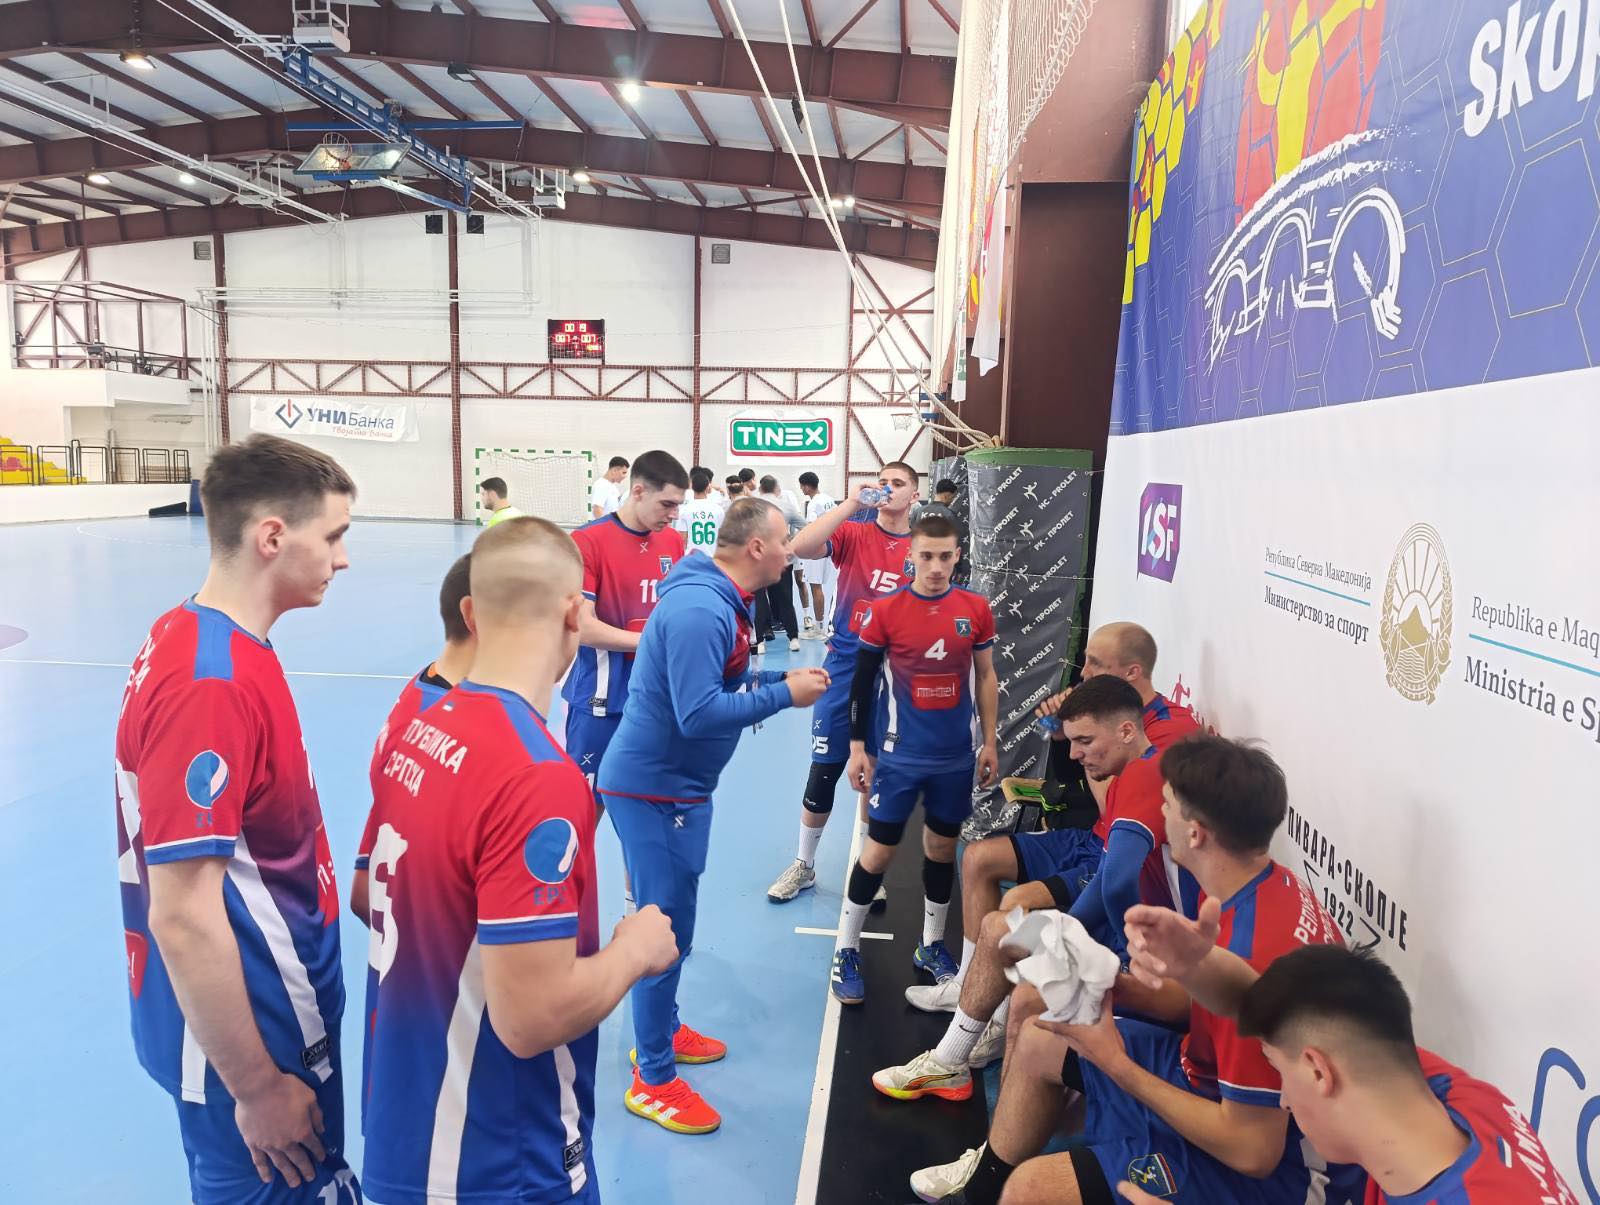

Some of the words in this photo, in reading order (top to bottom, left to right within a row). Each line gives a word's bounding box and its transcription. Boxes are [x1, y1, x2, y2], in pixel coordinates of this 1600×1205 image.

[737, 426, 824, 447] TINEX
[998, 466, 1023, 493] PROLET
[1052, 470, 1078, 497] PROLET
[692, 511, 714, 520] KSA
[1047, 510, 1075, 539] ПРОЛЕТ
[691, 521, 716, 546] 66
[869, 568, 901, 593] 15
[1042, 555, 1068, 580] PROLET
[1265, 547, 1296, 569] Република
[1296, 555, 1323, 578] Северна
[1325, 561, 1372, 592] Македонија
[639, 579, 658, 604] 11
[1035, 597, 1063, 623] ПРОЛЕТ
[1264, 585, 1323, 625] Министерство
[1324, 612, 1335, 630] за
[1337, 617, 1369, 645] спорт
[1471, 596, 1544, 637] Republika
[1548, 621, 1558, 640] e
[924, 638, 948, 661] 4
[1028, 642, 1055, 667] PROLET
[1464, 656, 1556, 717] Ministria
[1562, 699, 1575, 723] e
[1323, 887, 1354, 937] 1922
